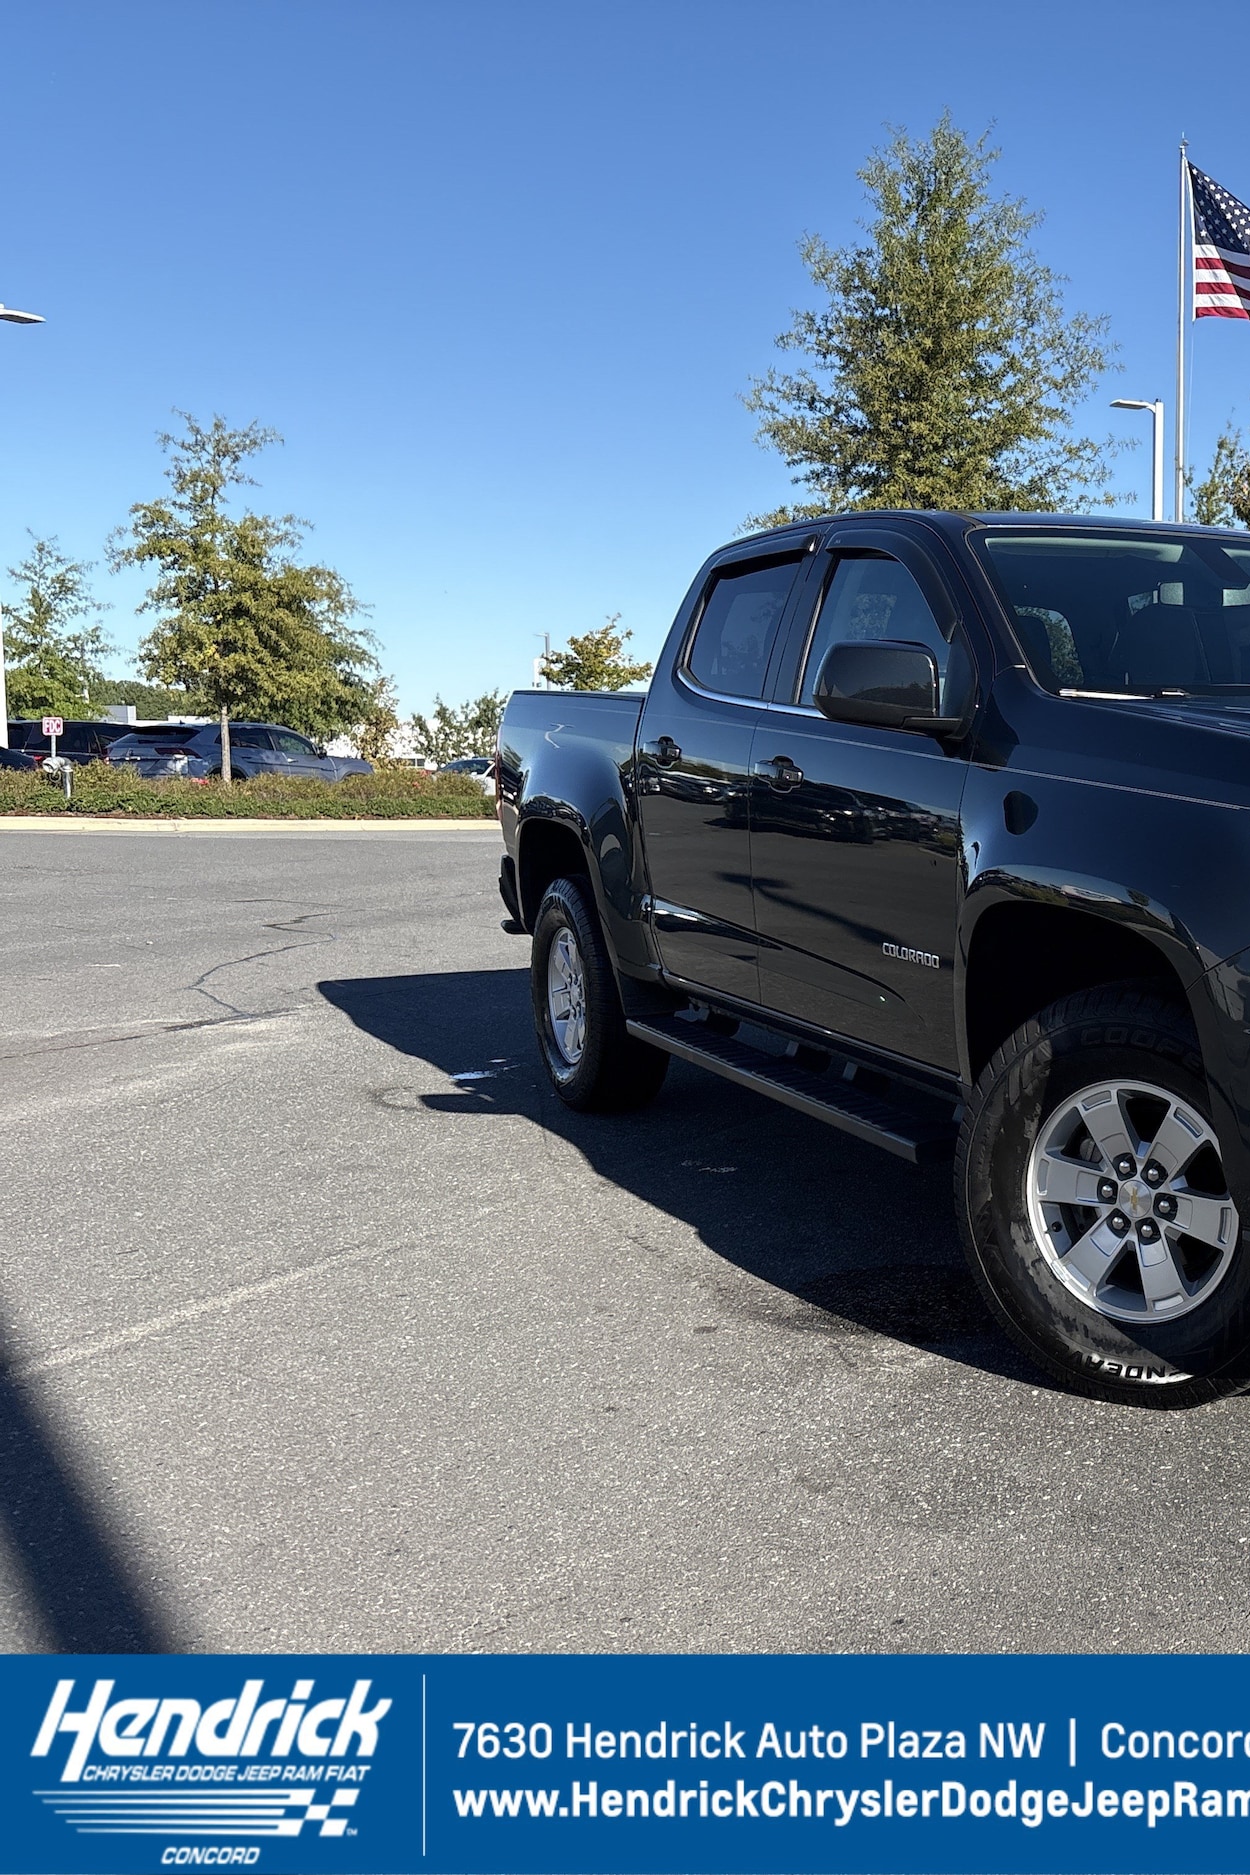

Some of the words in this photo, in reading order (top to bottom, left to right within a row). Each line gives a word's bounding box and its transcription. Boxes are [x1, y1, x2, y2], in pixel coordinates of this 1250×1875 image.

[44, 719, 61, 733] FDC
[882, 942, 940, 969] COLORADO
[1080, 1026, 1203, 1071] COOPE
